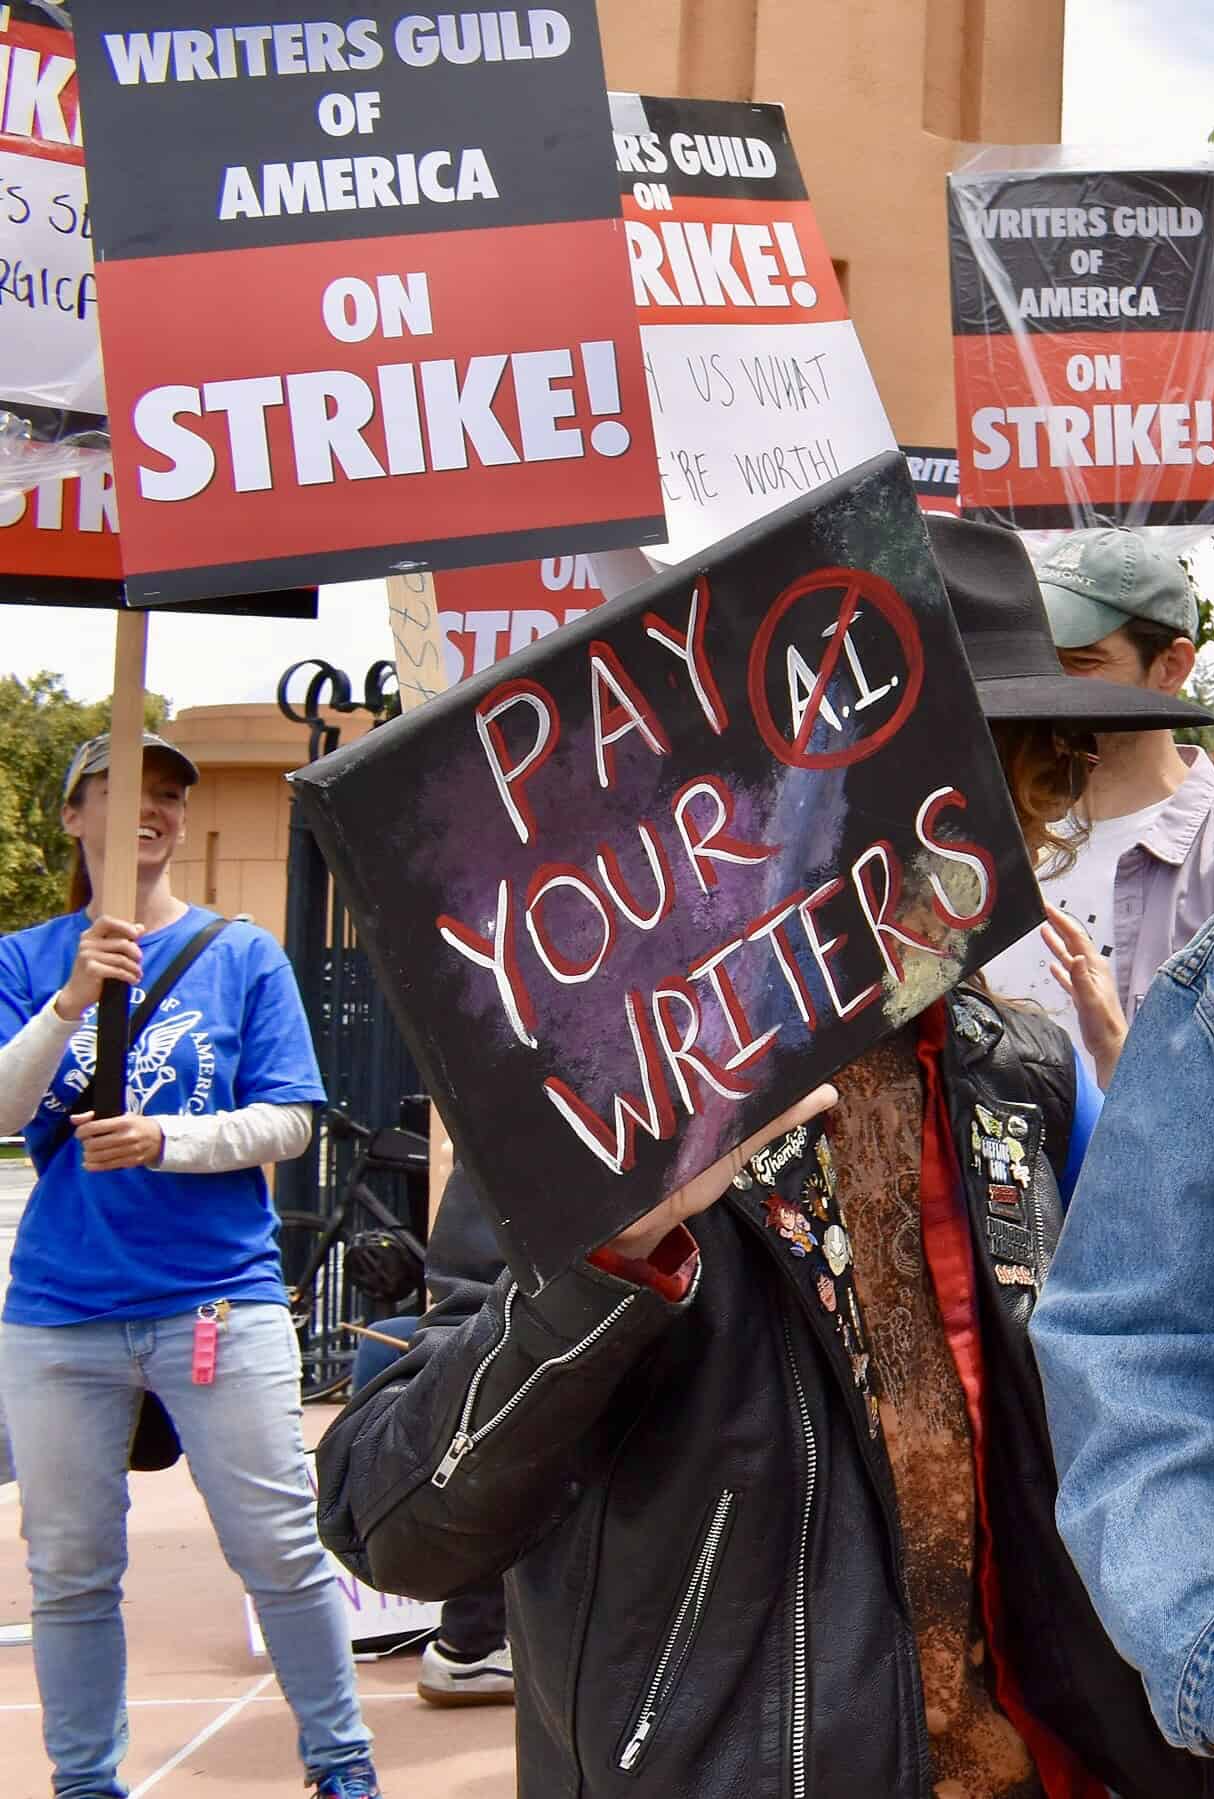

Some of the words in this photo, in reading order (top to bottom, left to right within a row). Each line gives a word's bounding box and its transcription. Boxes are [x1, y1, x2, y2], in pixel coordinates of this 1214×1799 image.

[104, 19, 383, 85] WRITERS
[394, 9, 571, 67] GUILD
[317, 92, 381, 137] OF
[218, 148, 499, 220] AMERICA
[670, 132, 776, 178] GUILD
[632, 182, 673, 211] ON
[966, 207, 1106, 239] WRITERS
[1114, 207, 1203, 239] GUILD
[1070, 249, 1103, 275] OF
[321, 272, 433, 343] ON
[1018, 288, 1160, 318] AMERICA
[687, 354, 734, 407] US
[740, 353, 831, 411] WHAT
[1066, 354, 1121, 391] ON
[133, 340, 631, 502] STRIKE!
[475, 574, 729, 844] PAY
[786, 611, 899, 738] A.I.
[436, 775, 779, 1048] YOUR
[544, 786, 994, 1175] WRITERS
